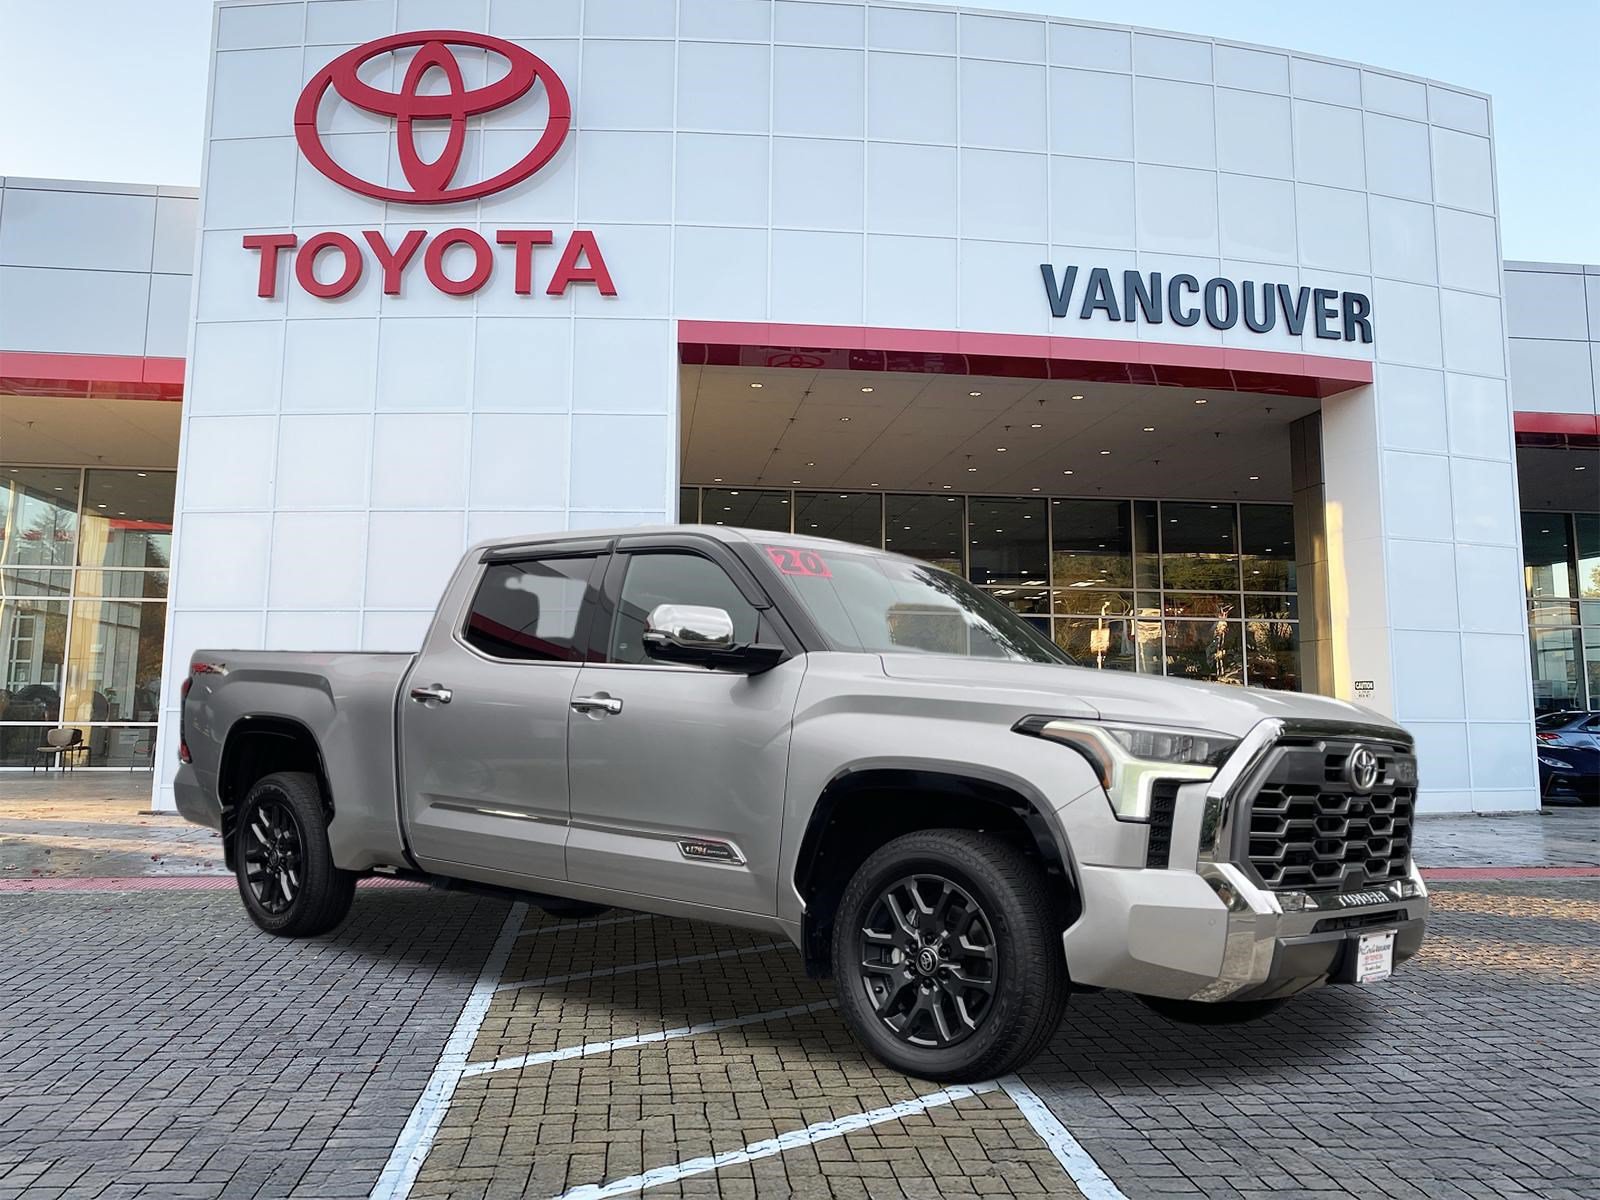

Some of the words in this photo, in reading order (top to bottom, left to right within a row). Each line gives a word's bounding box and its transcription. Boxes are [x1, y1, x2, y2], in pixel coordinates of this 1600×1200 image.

[243, 228, 618, 298] TOYOTA
[1040, 264, 1374, 344] VANCOUVER
[769, 548, 827, 575] 20
